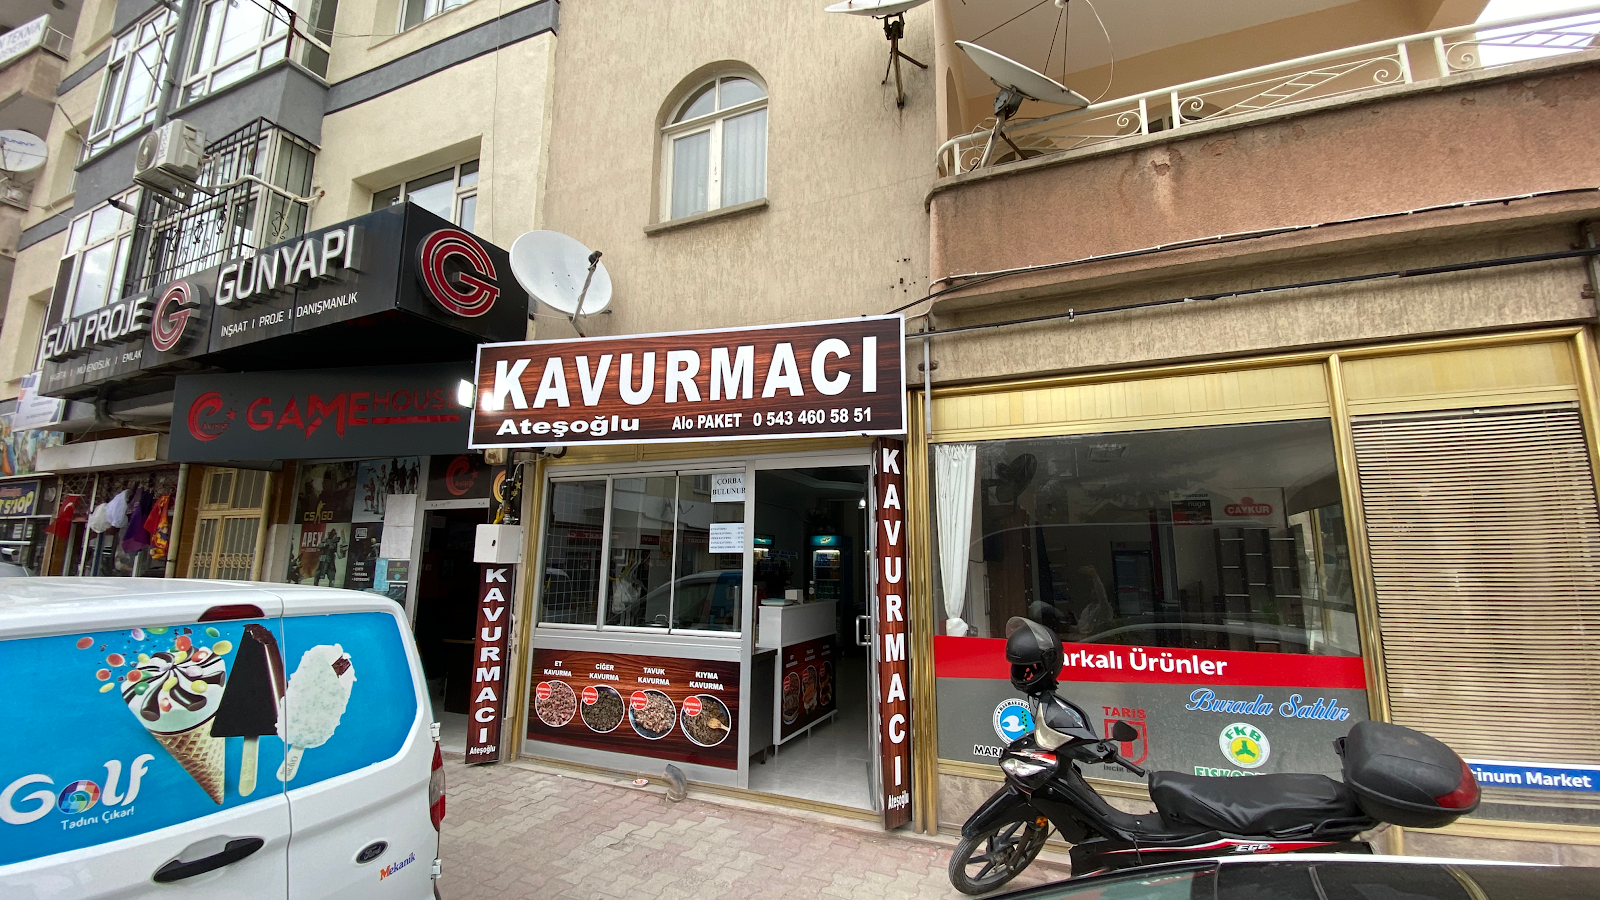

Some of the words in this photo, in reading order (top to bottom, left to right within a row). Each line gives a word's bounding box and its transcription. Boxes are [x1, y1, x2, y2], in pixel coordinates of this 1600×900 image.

[220, 321, 249, 338] İNŞAAT
[259, 311, 285, 328] PROJE
[296, 292, 359, 318] DANIŞMANLIK
[43, 318, 82, 360] GÜN
[81, 296, 148, 348] PROJE
[122, 349, 144, 363] EMLAK
[492, 335, 877, 411] KAVURMACI
[496, 414, 640, 438] Ateşoğlu
[672, 415, 694, 431] Alo
[697, 412, 743, 429] PAKET
[752, 412, 762, 427] 0
[766, 410, 794, 427] 543
[797, 408, 826, 425] 460
[830, 407, 849, 424] 58
[853, 406, 872, 422] 51
[716, 477, 742, 486] ÇORBA
[712, 487, 746, 496] BULUNUR
[301, 531, 323, 548] APEX
[881, 447, 906, 786] KAVURMACI
[474, 568, 508, 744] KAVURMACI
[1062, 649, 1123, 670] arkalı
[1129, 647, 1228, 676] Ürünler
[543, 668, 572, 677] KAVURMA
[595, 662, 614, 671] CİĞER
[643, 667, 665, 676] TAVUK
[589, 672, 619, 682] KAVURMA
[637, 676, 670, 686] KAVURMA
[695, 671, 718, 680] KIYMA
[689, 680, 724, 691] KAVURMA
[1185, 688, 1274, 716] Burada
[1278, 693, 1351, 722] Satılır
[1224, 726, 1262, 742] FKB
[469, 744, 496, 756] Ateşoğlu
[1525, 771, 1592, 788] Market
[0, 753, 156, 825] Golf
[887, 789, 910, 811] Ateşoğlu
[60, 815, 99, 831] Tadını
[101, 806, 135, 824] Çıkar!
[379, 851, 416, 882] Mekanik
